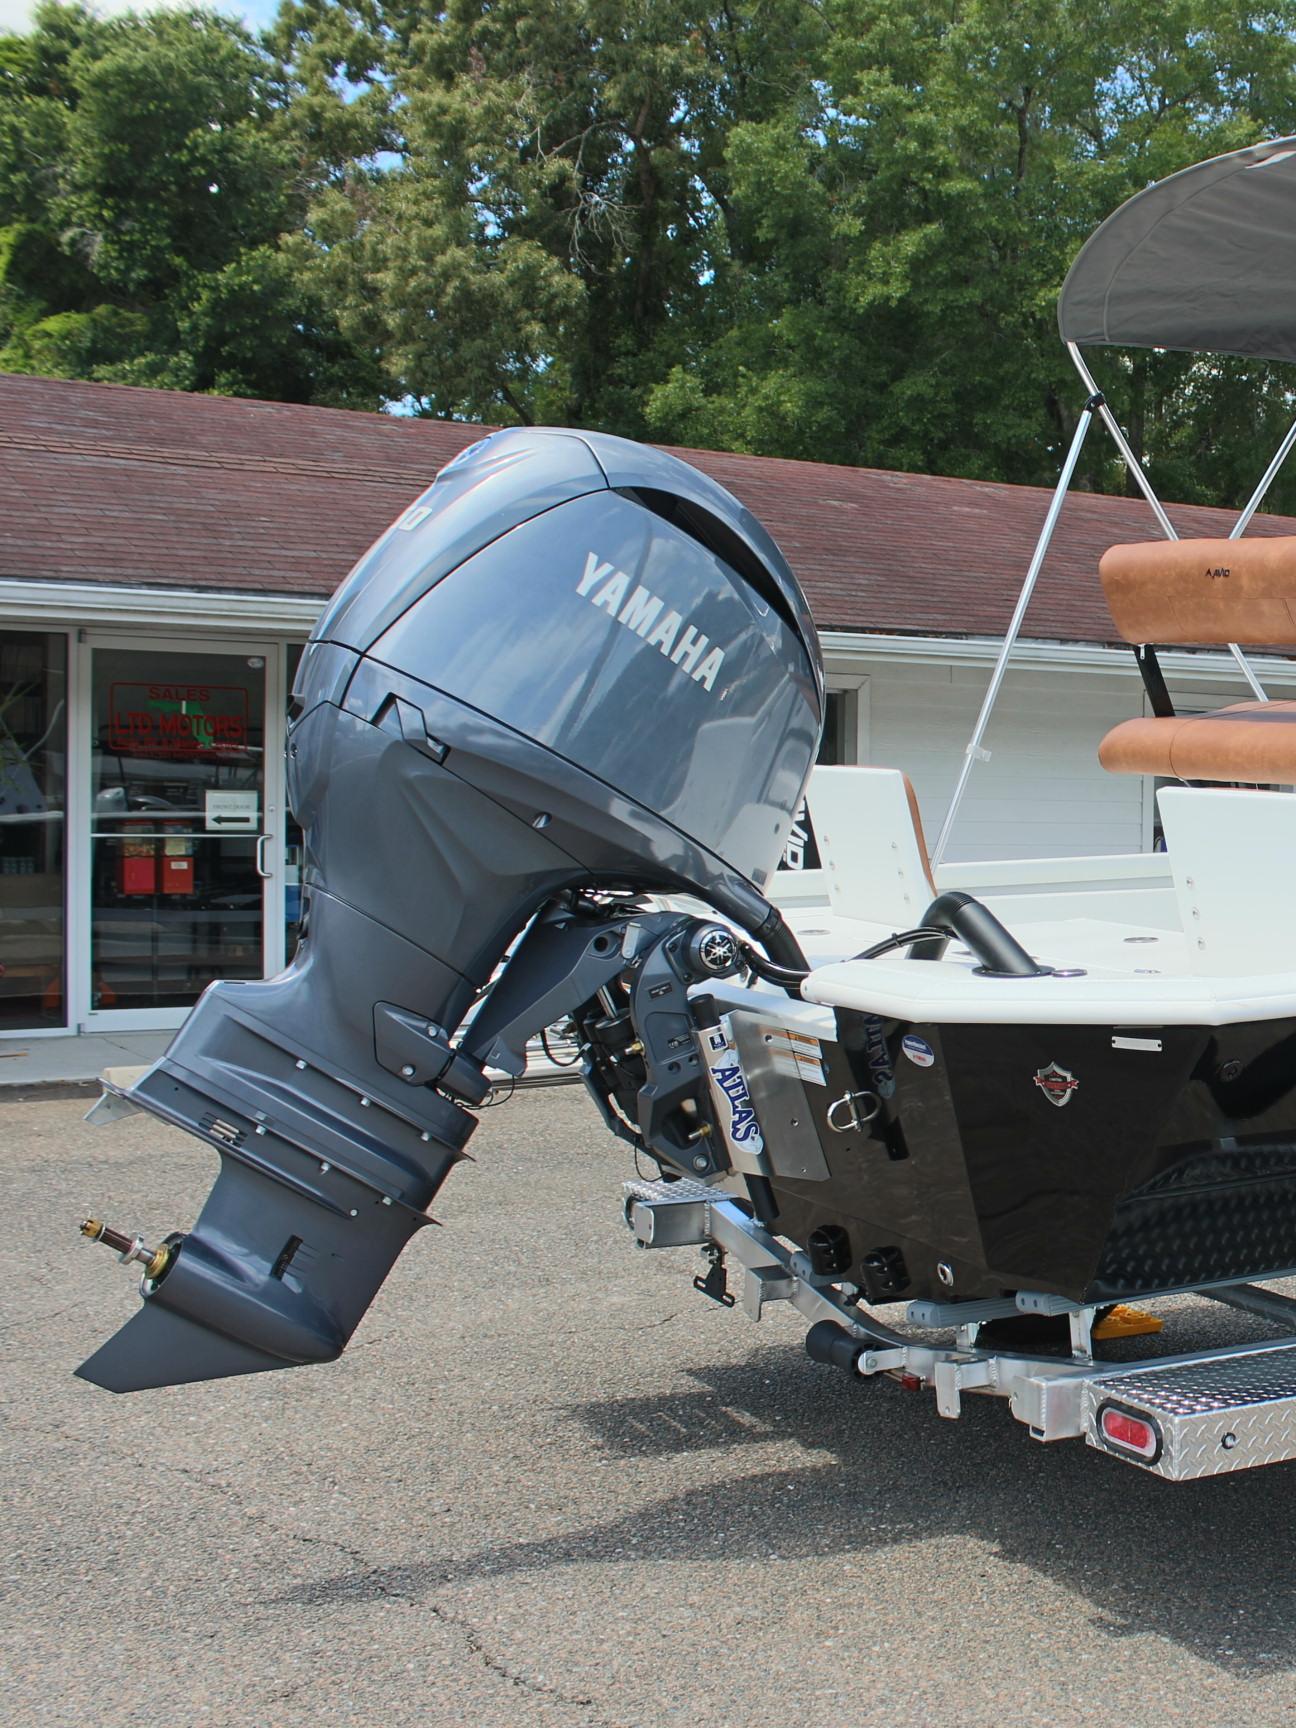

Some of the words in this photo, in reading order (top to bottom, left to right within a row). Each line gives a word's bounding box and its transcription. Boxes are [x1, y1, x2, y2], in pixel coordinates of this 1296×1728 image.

[575, 553, 726, 691] YAMAHA
[149, 686, 210, 701] SALES
[114, 711, 152, 735] LTD
[159, 714, 242, 738] MOTORS
[710, 1065, 761, 1142] ATLAS
